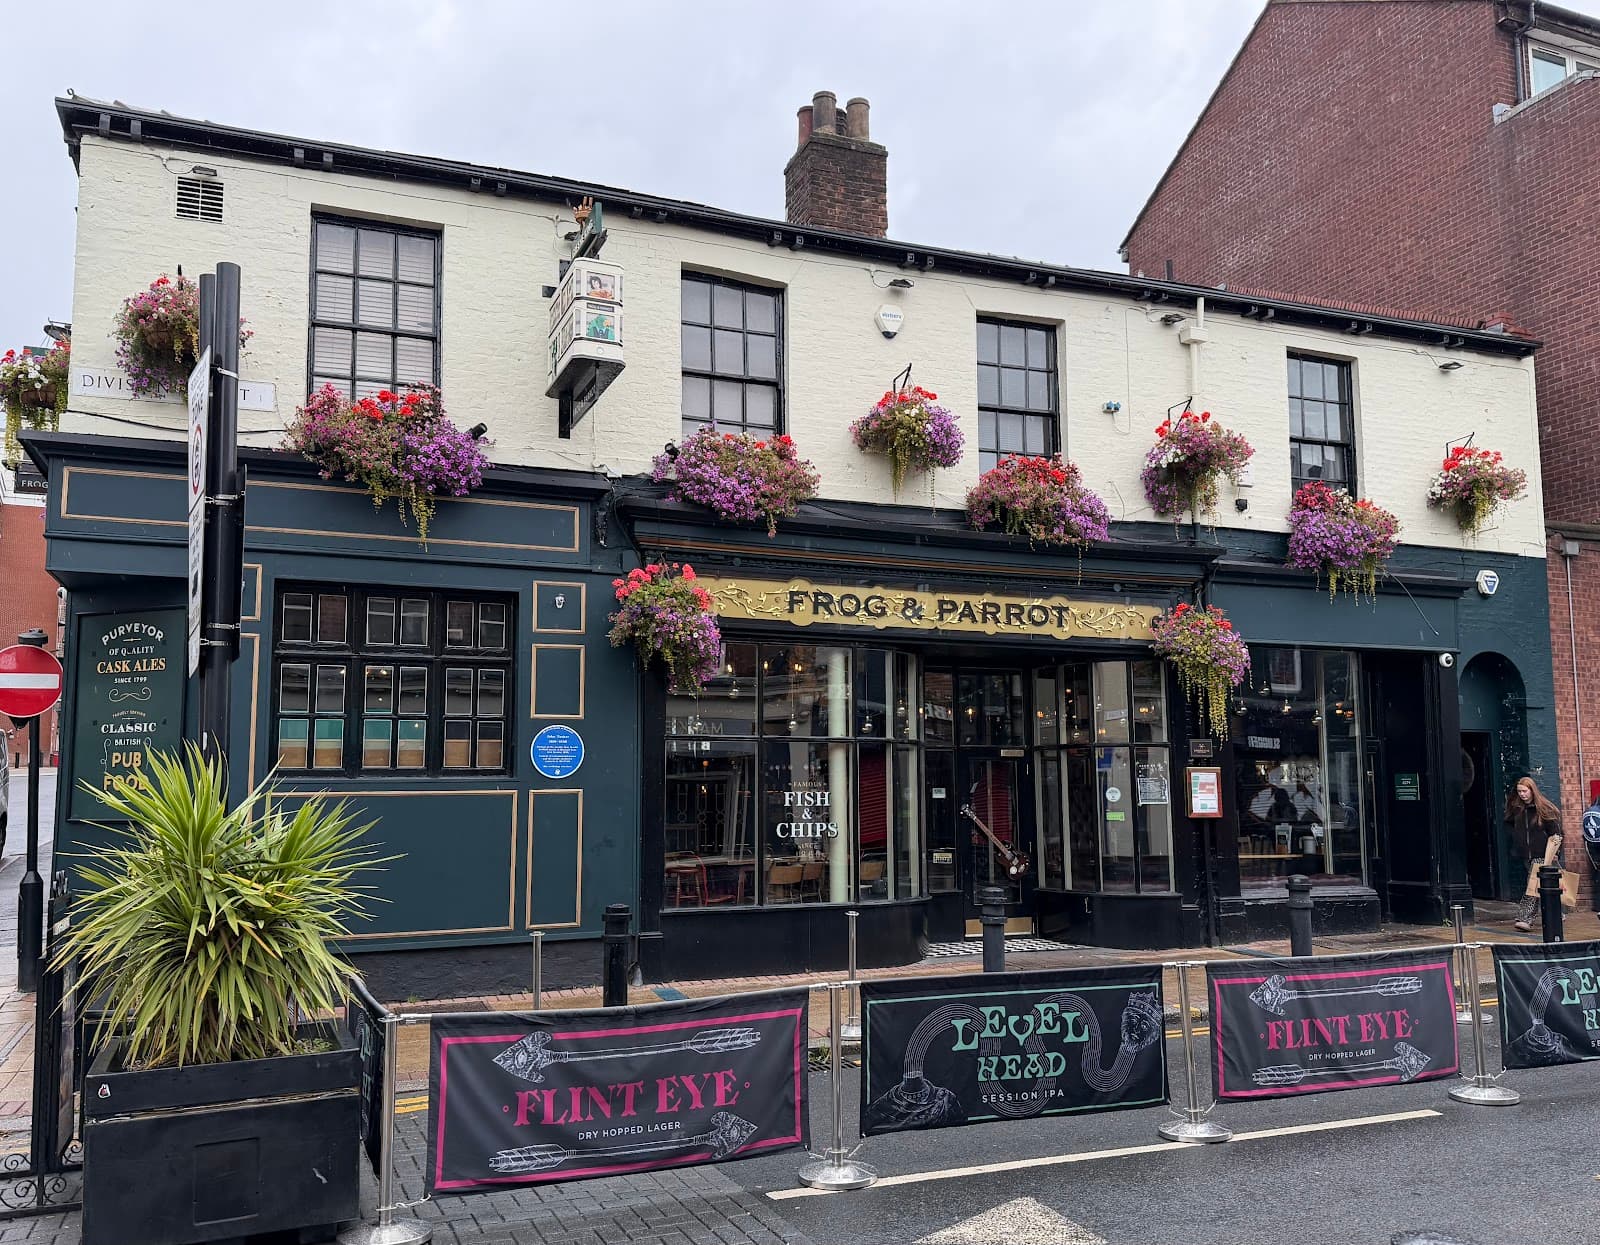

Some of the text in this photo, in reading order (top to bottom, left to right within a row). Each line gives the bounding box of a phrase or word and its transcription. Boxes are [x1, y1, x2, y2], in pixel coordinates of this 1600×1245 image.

[82, 374, 169, 395] DIVISN
[21, 480, 48, 489] FROG
[787, 590, 1070, 628] FROG & PARROT
[101, 623, 164, 646] PURVEYOR
[109, 648, 119, 656] OF
[97, 657, 166, 674] CASK ALES
[101, 722, 157, 734] CLASSIC
[114, 738, 141, 746] BRITISH
[111, 751, 142, 768] PUB
[783, 791, 831, 807] FISH
[801, 807, 813, 820] &
[776, 822, 839, 838] CHIPS
[1556, 968, 1600, 1005] LE
[951, 1003, 1090, 1051] LEVEL
[1266, 1008, 1413, 1050] FLINT EYE
[1308, 1048, 1376, 1061] DRY HOPPED LAGER
[978, 1052, 1066, 1082] HEAD
[513, 1068, 740, 1127] FLINT EYE
[982, 1088, 1065, 1103] SESSION IPA
[578, 1121, 681, 1141] DRY HOPPED LAGER
